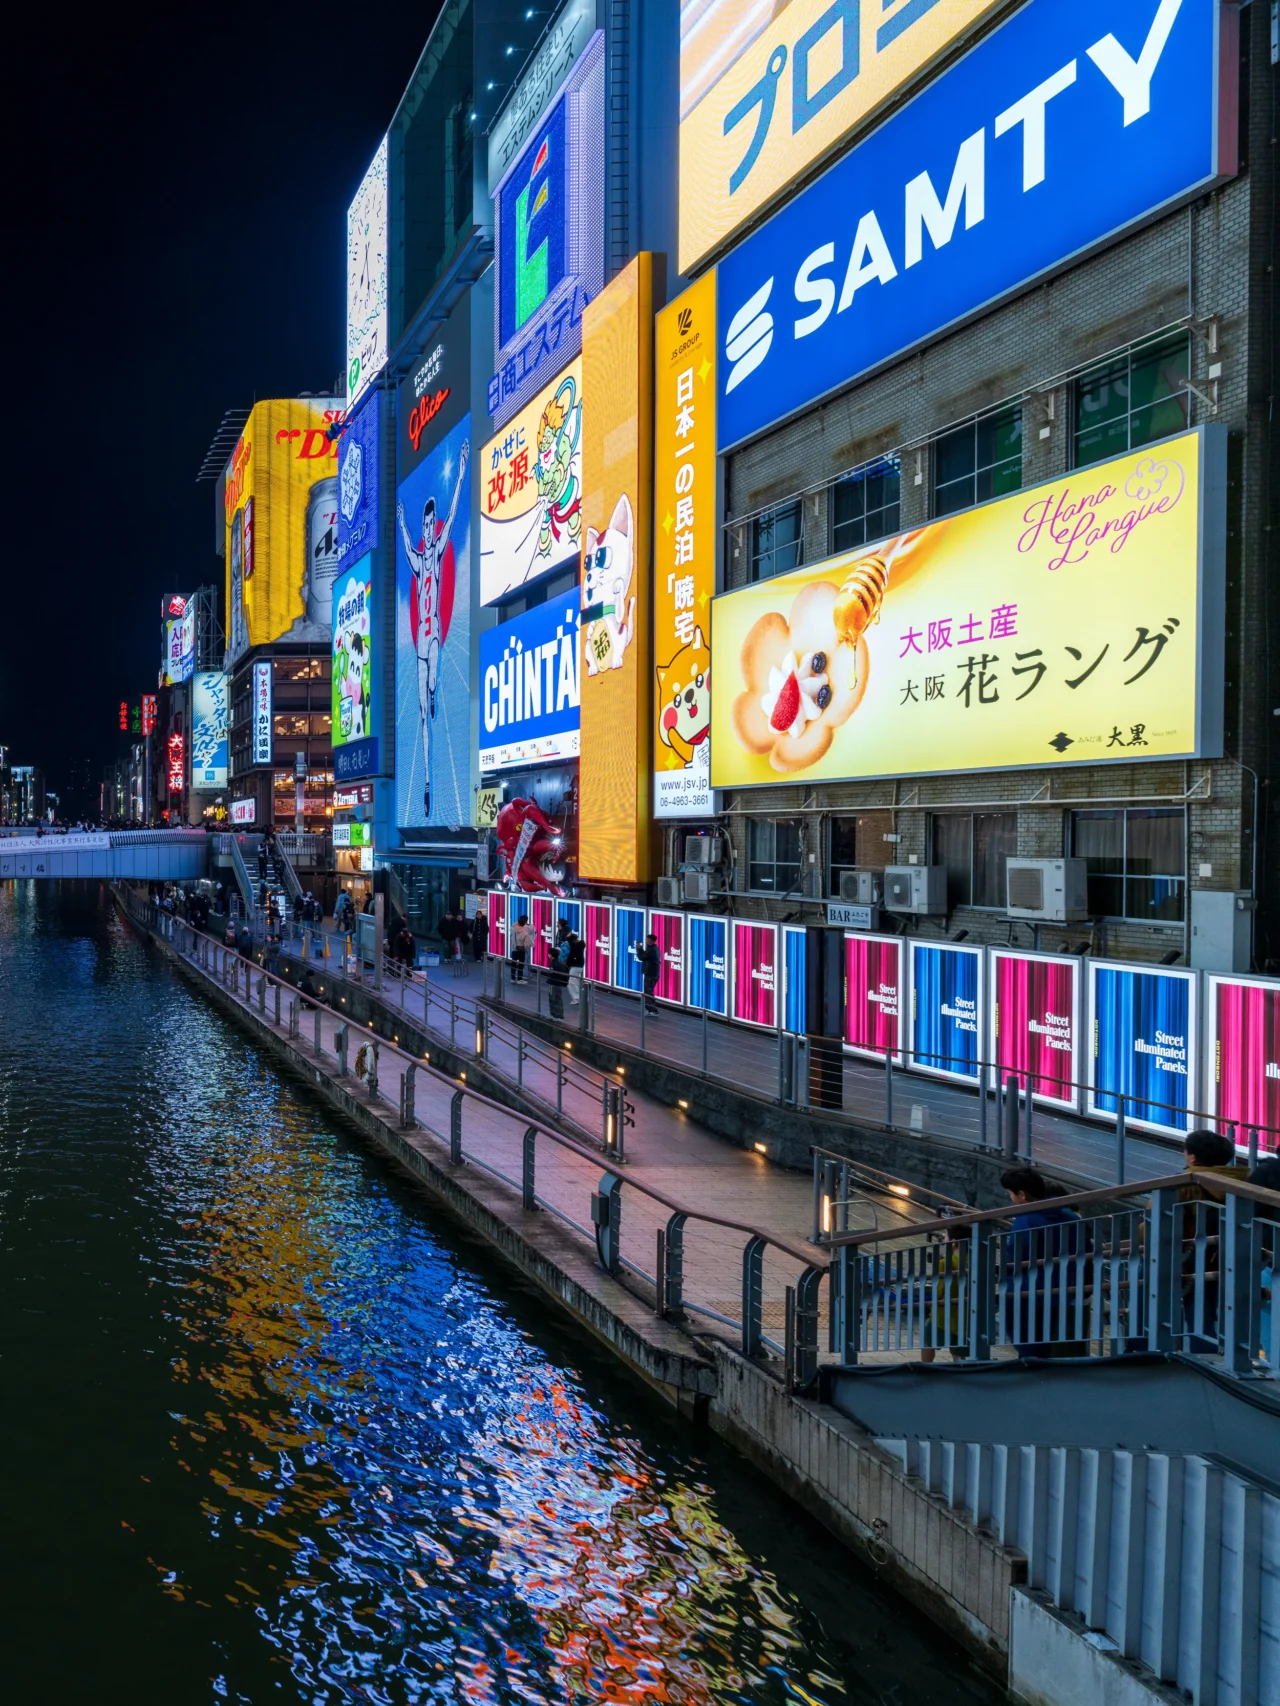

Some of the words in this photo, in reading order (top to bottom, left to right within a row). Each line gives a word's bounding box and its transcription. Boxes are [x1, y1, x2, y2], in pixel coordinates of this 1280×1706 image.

[794, 0, 1183, 340] SAMTY
[408, 387, 451, 452] Glico
[492, 427, 525, 470] かぜに
[675, 366, 695, 567] 日本一の民泊
[488, 447, 529, 514] 改源
[1016, 481, 1117, 554] Hana
[1047, 496, 1173, 571] Langue
[898, 602, 1019, 659] 大阪土産
[899, 673, 946, 707] 大阪
[955, 617, 1181, 710] 花ラング
[1106, 723, 1149, 748] 大黒
[660, 796, 708, 807] 06-4963-3661
[661, 777, 708, 791] www.jsv.jp
[830, 909, 851, 922] BAR
[955, 996, 975, 1010] Street
[1045, 1011, 1069, 1027] Street
[1155, 1029, 1184, 1047] Street
[1155, 1056, 1188, 1075] Panels.
